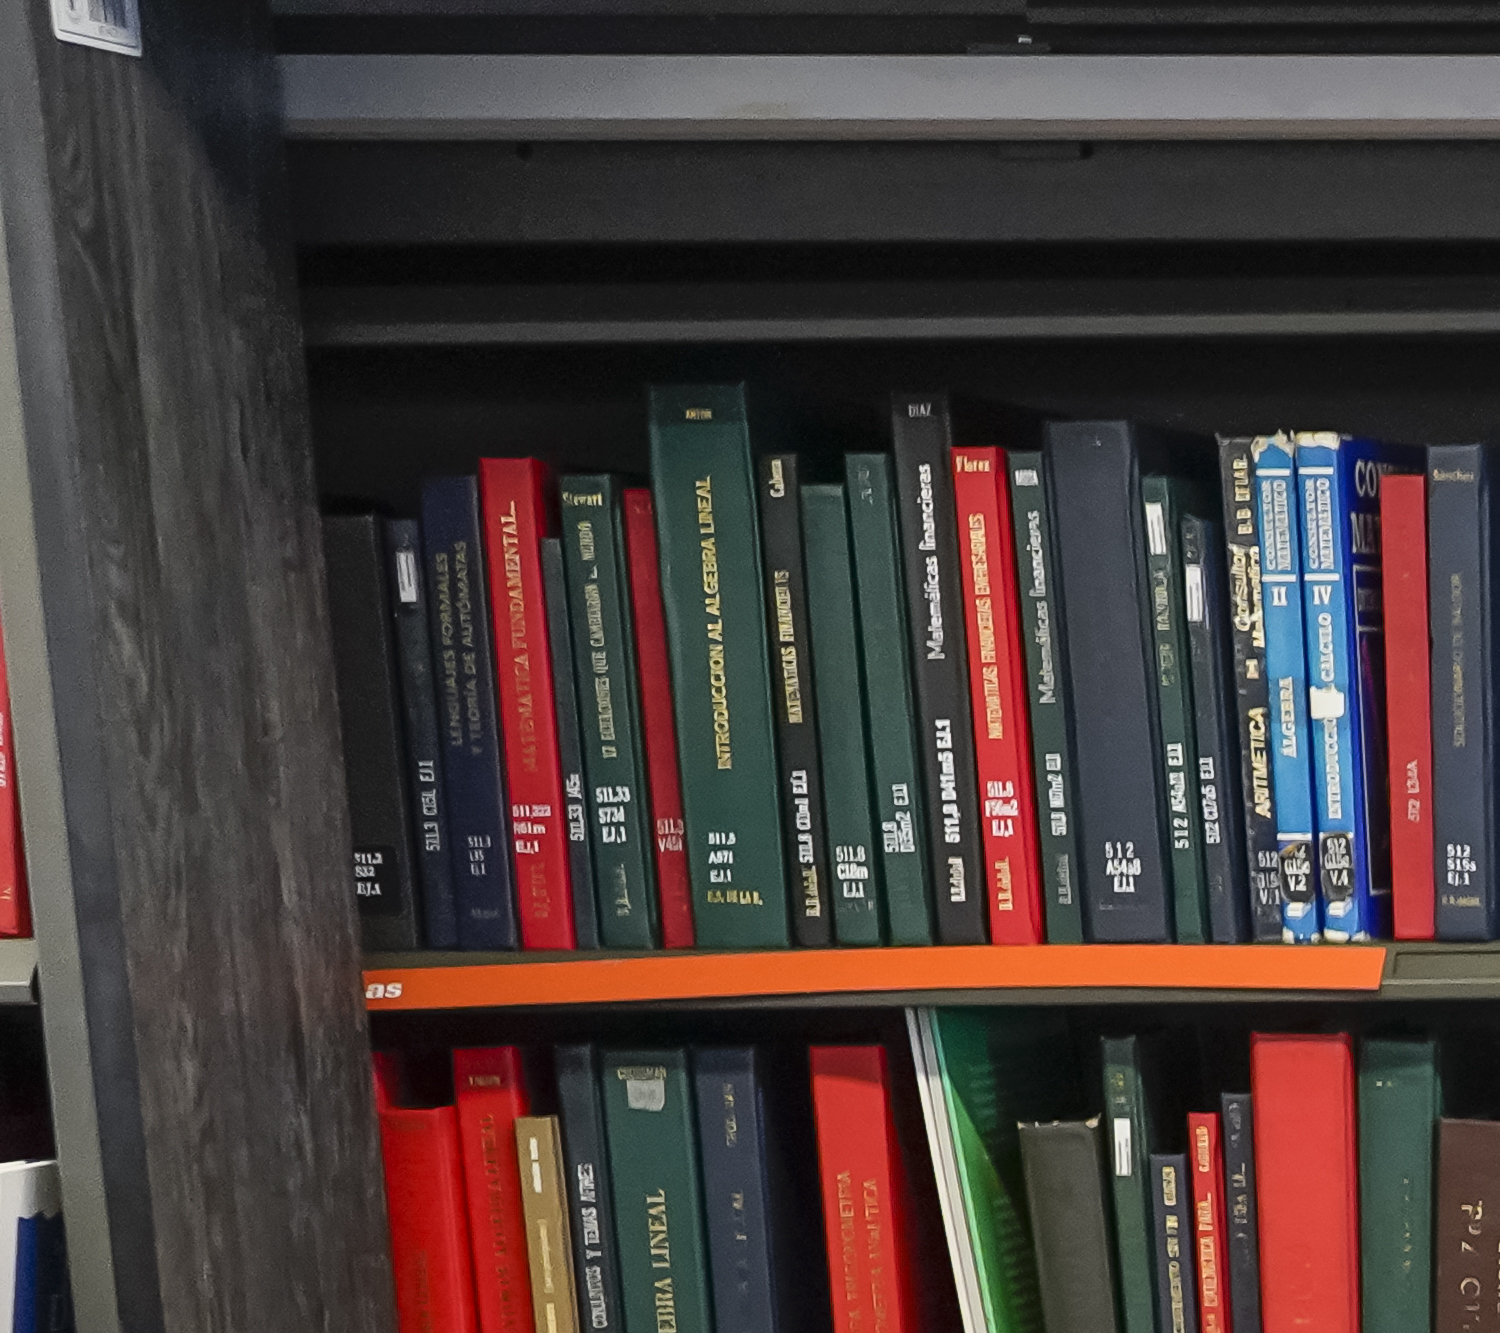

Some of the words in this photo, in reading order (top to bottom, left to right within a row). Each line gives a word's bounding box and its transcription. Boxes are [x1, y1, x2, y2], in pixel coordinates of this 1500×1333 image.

[695, 476, 715, 534] LINEAL
[917, 464, 936, 550] financieras
[701, 538, 721, 616] ALGEBRA
[1025, 510, 1047, 596] financieras
[1312, 586, 1331, 605] IV
[436, 553, 453, 645] FORMALES
[707, 619, 723, 641] AL
[922, 556, 945, 660] Matemáticas
[460, 653, 476, 674] DE
[1032, 601, 1056, 704] Matemáticas
[442, 651, 463, 746] LENGUAJES
[709, 645, 732, 769] INTRODUCCION
[1248, 707, 1271, 818] ARITMETICA
[581, 1207, 601, 1245] TEMAS
[645, 1189, 673, 1269] LINEAL
